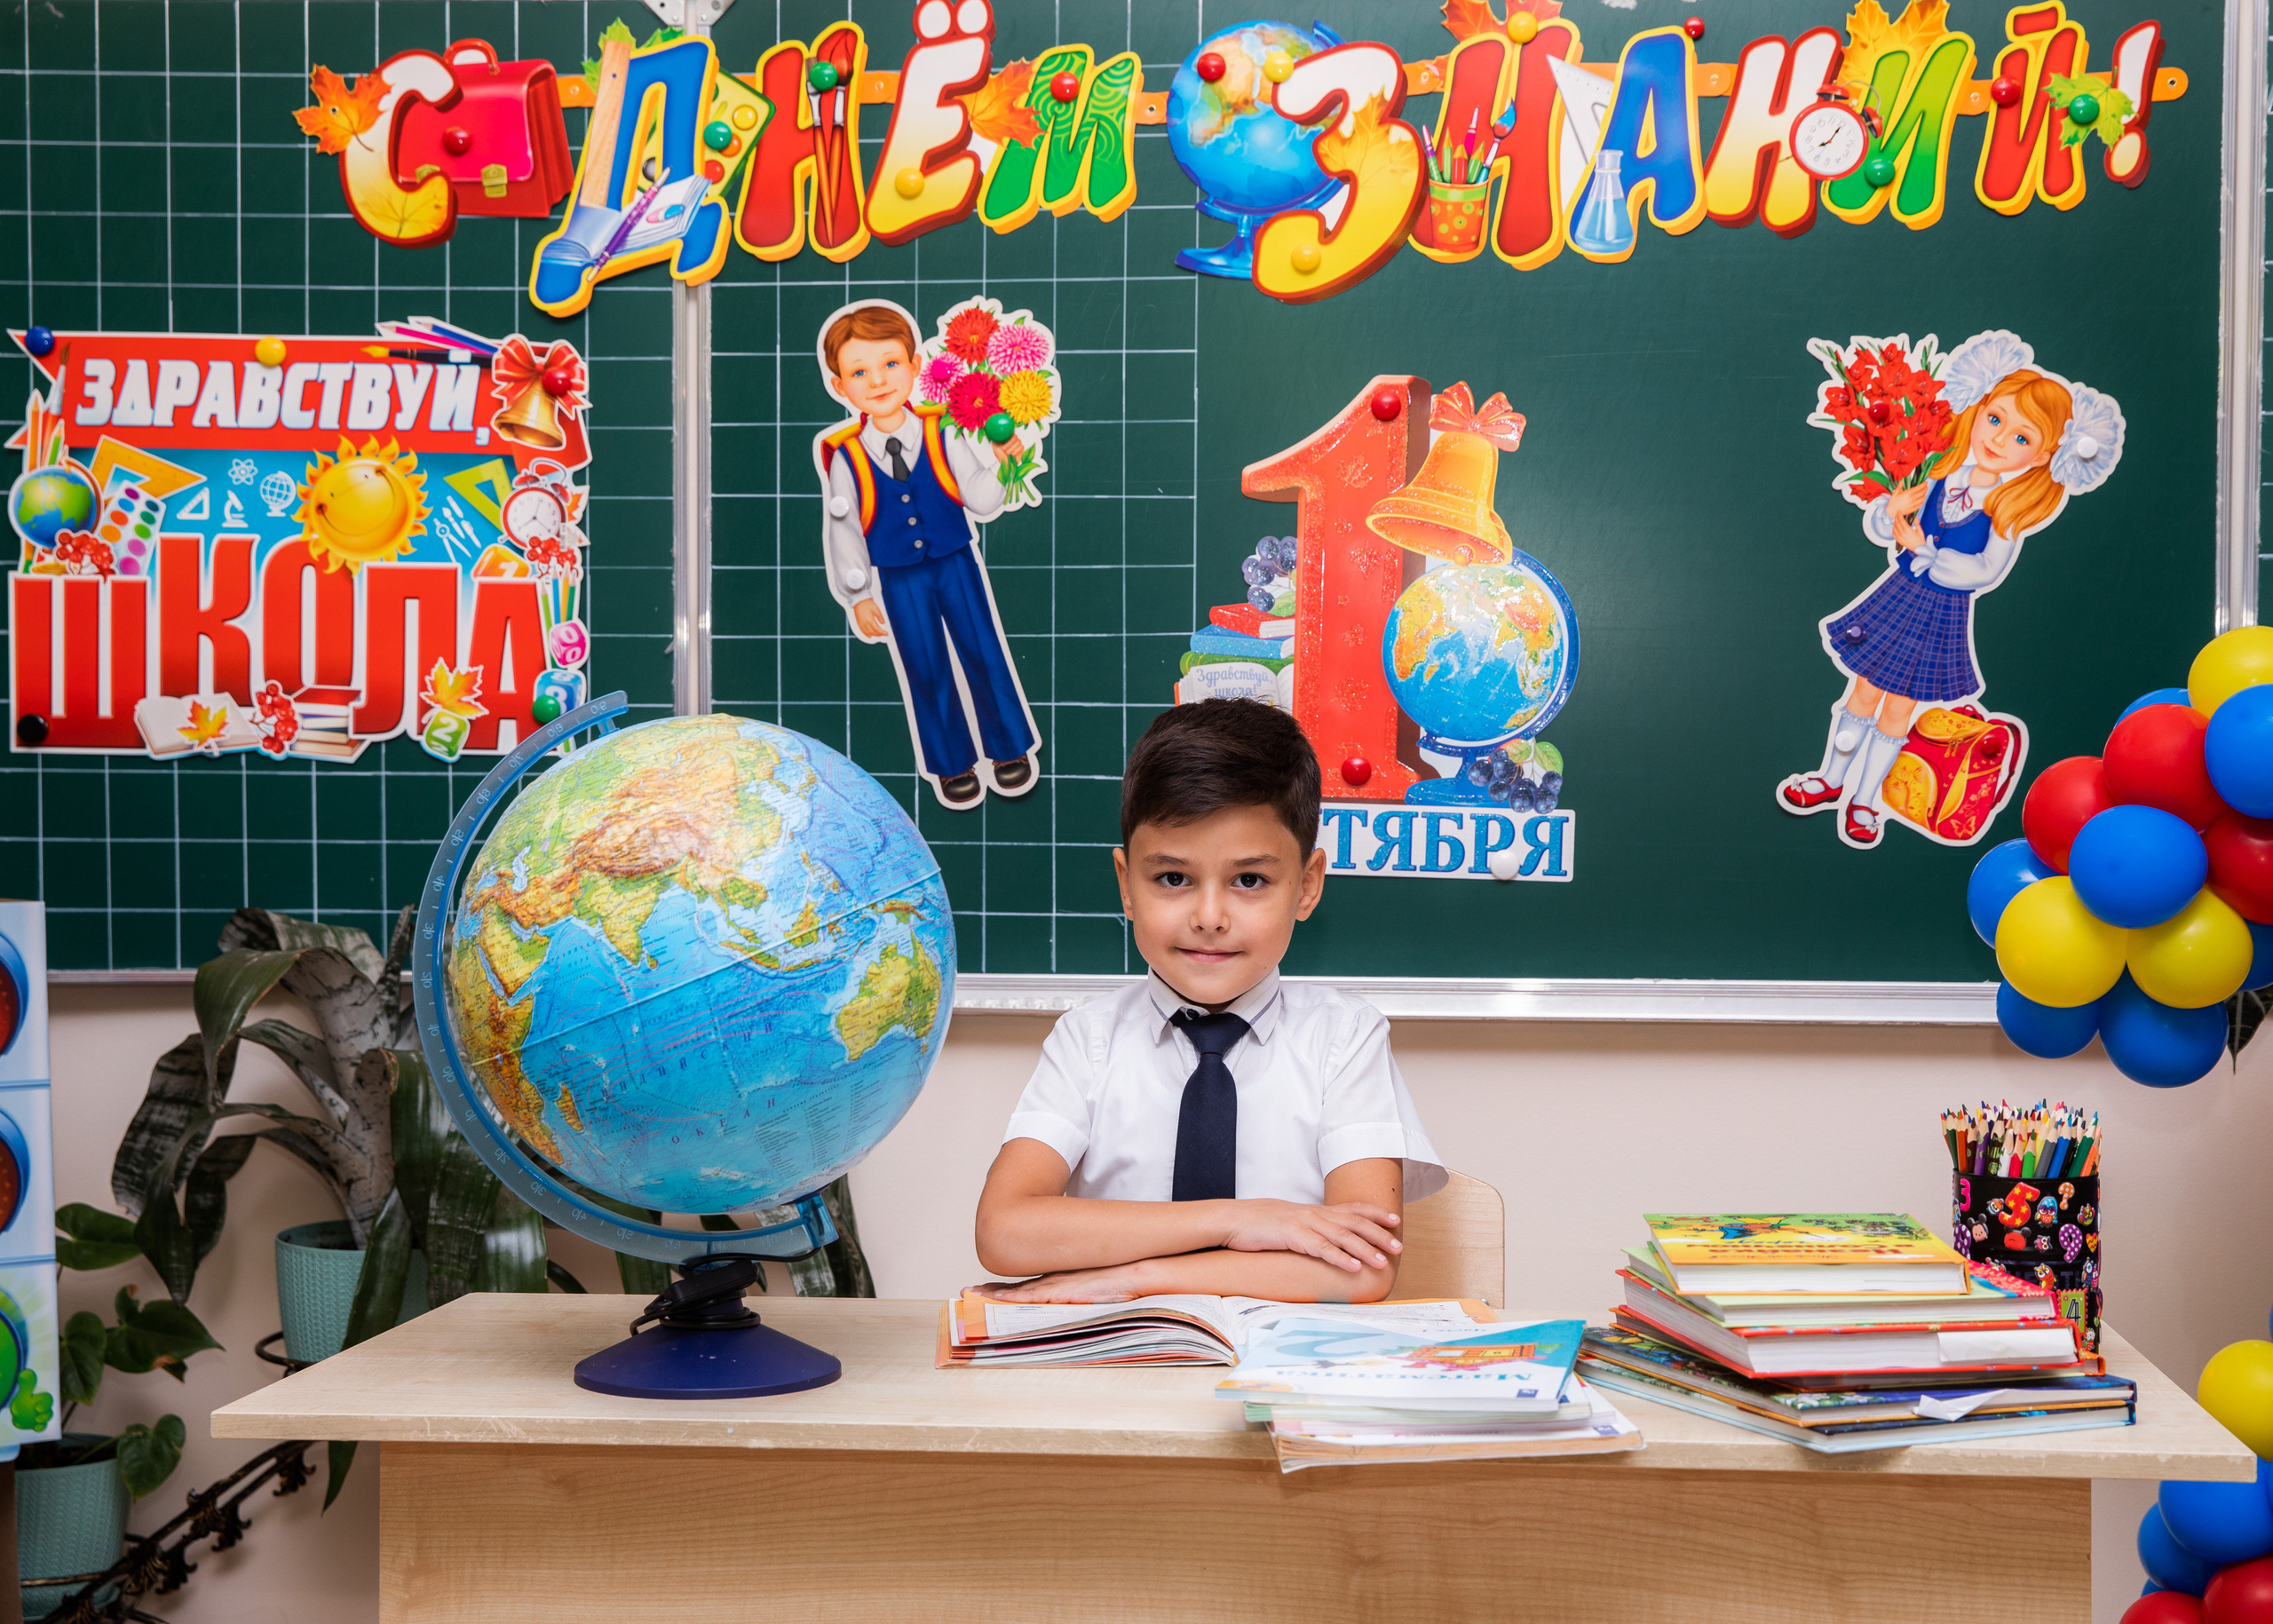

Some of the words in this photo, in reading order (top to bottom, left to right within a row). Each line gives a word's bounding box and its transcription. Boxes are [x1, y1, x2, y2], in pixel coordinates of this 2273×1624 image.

[338, 49, 463, 249] С
[530, 0, 1139, 318] ДНЁМ
[1252, 0, 2165, 304] ЗНАНИЙ!
[76, 349, 490, 447] ЗДРАВСТВУЙ,
[14, 534, 544, 749] ШКОЛА
[1196, 666, 1273, 687] Здравствуй,
[1215, 684, 1256, 698] школа!
[1320, 808, 1570, 876] ТЯБРЯ
[671, 1097, 776, 1145] ОКЕАН
[1999, 1182, 2040, 1227] 5
[2058, 1224, 2083, 1264] 9
[2066, 1298, 2082, 1327] 4
[1276, 1330, 1384, 1358] 2
